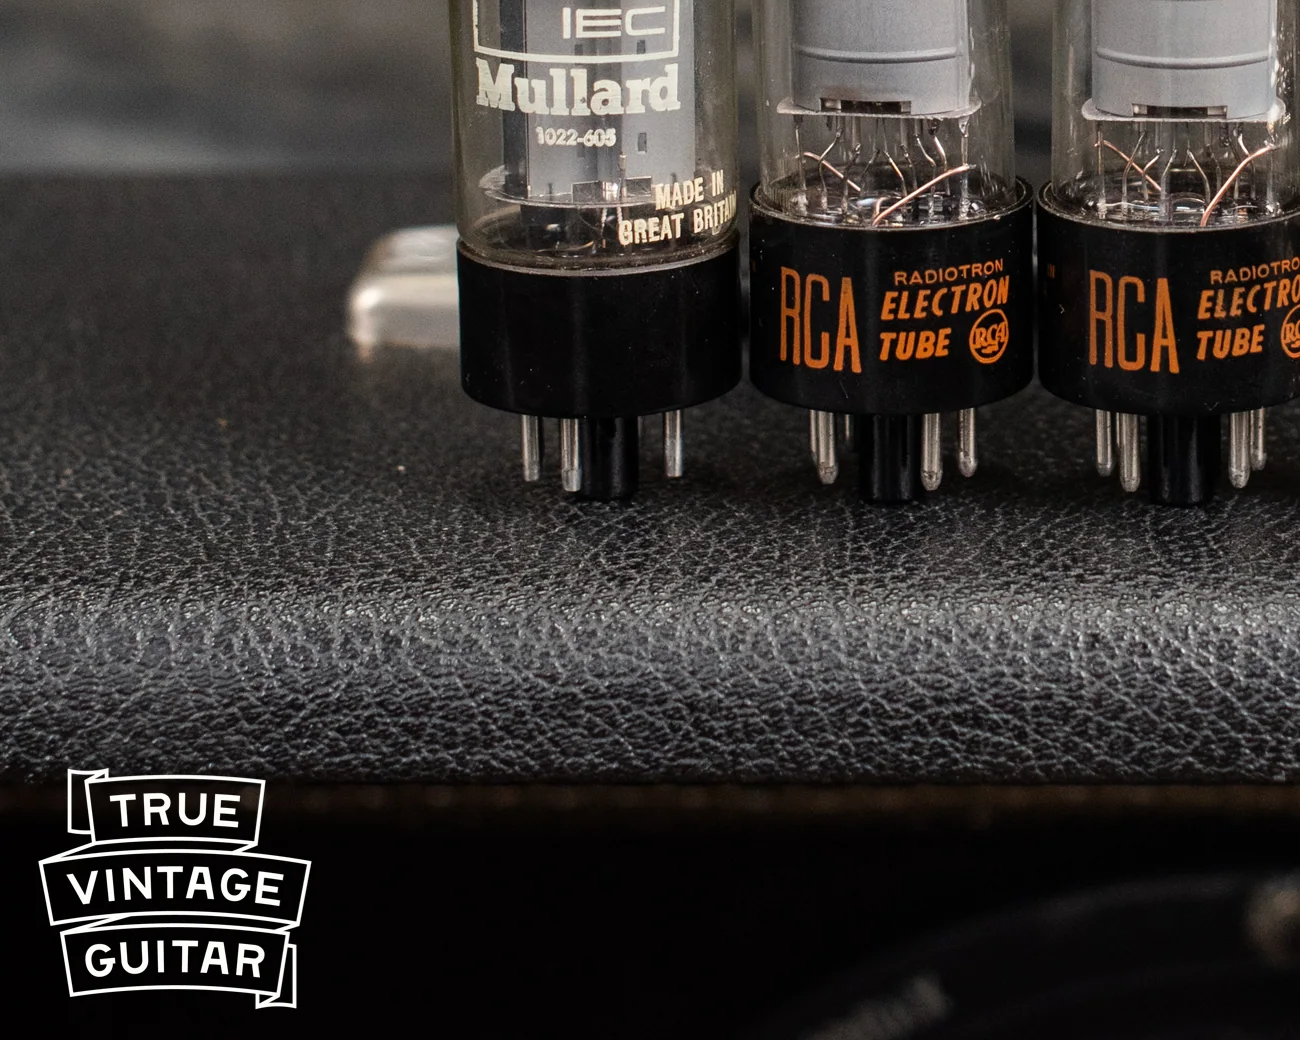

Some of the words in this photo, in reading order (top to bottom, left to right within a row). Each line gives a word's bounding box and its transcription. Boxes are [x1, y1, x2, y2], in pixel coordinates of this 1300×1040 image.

[562, 6, 667, 40] IEC
[475, 57, 681, 117] Mullard
[535, 126, 617, 148] 1022-605
[653, 176, 705, 211] MADE
[711, 169, 725, 197] IN
[618, 212, 685, 246] GREAT
[894, 258, 1004, 286] RADIOTRON
[880, 275, 1010, 321] ELECTRON
[779, 265, 862, 374] RCA
[879, 328, 952, 361] TUBE
[973, 319, 1009, 355] RCA
[1088, 268, 1180, 374] RCA
[1196, 324, 1266, 361] TUBE
